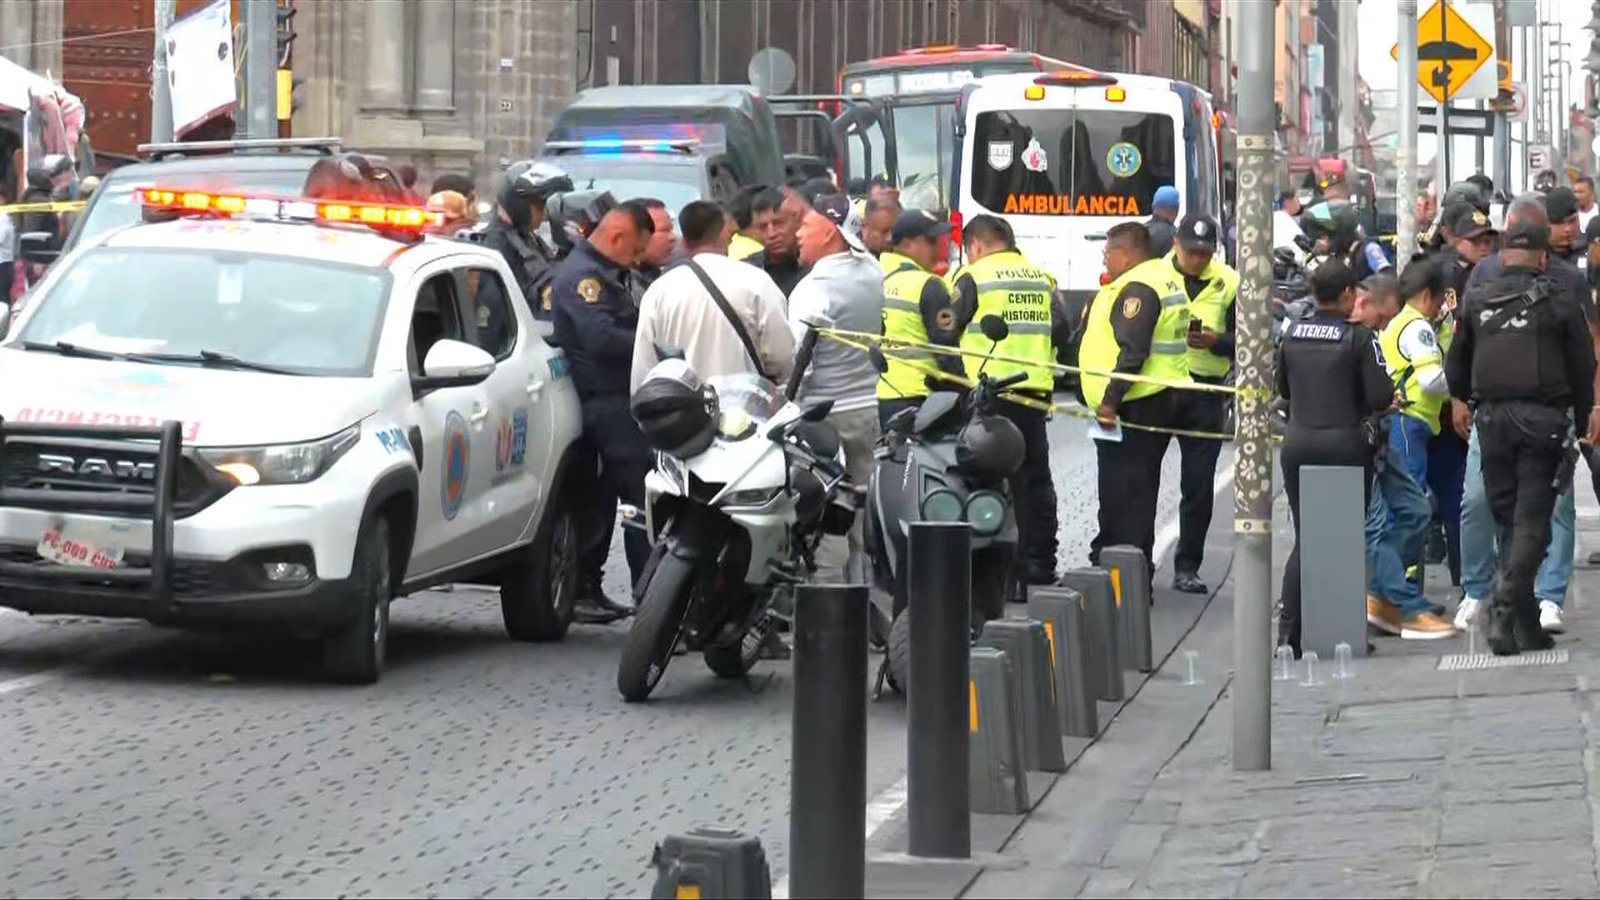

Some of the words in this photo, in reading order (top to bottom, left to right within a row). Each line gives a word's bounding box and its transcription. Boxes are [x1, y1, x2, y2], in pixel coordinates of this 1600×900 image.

[1003, 193, 1140, 215] AMBULANCIA
[1008, 292, 1044, 305] CENTRO
[1292, 323, 1341, 340] ATENEAS
[38, 454, 155, 479] RAM
